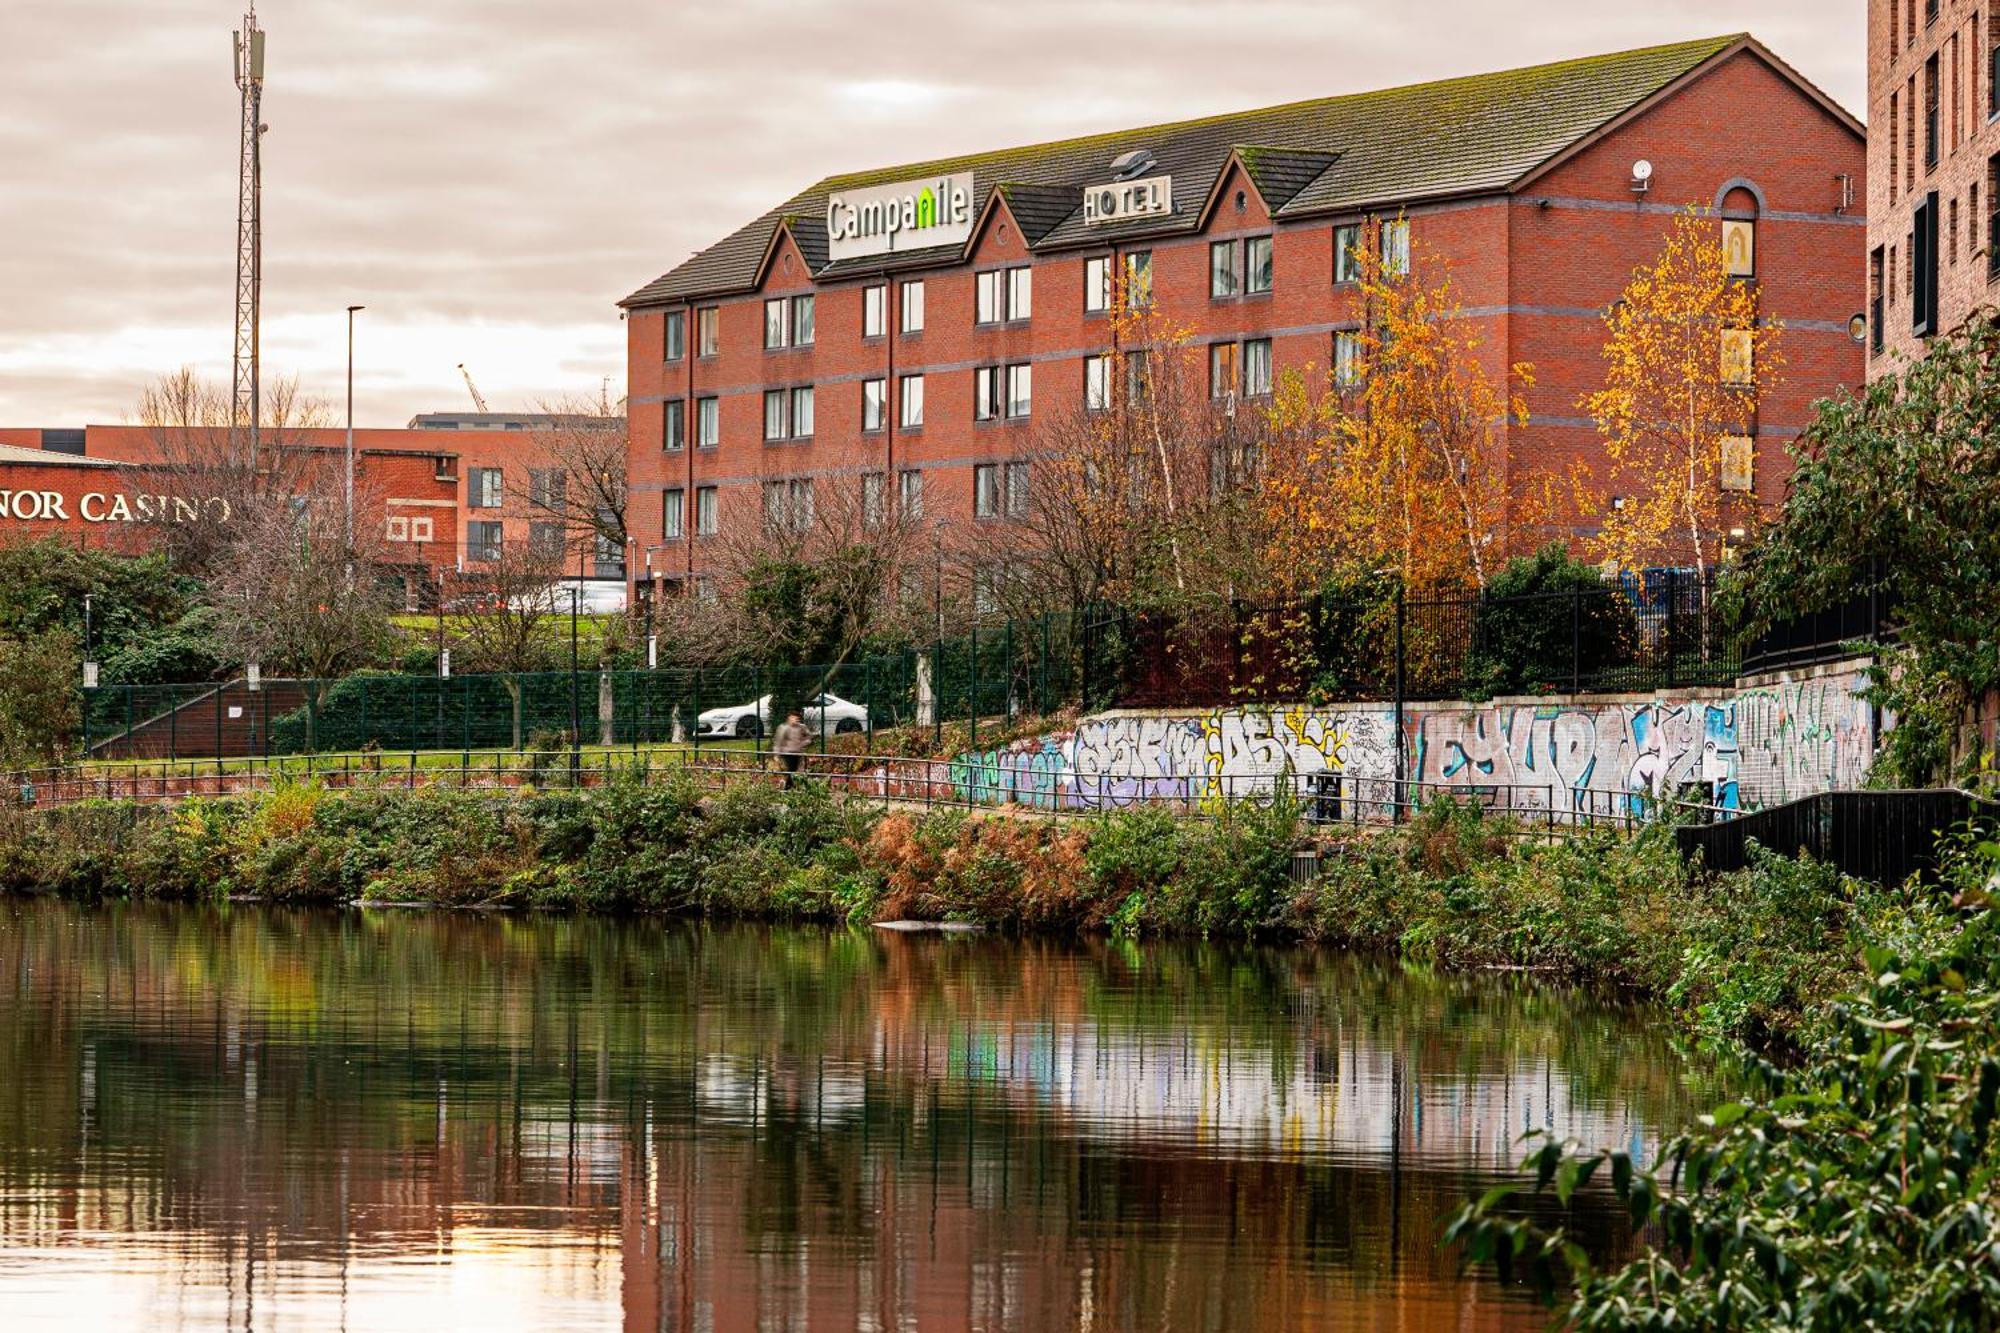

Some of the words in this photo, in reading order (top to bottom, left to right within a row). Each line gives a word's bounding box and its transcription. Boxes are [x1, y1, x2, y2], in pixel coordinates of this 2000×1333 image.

[828, 177, 968, 250] Campanile
[1084, 184, 1163, 218] HOTEL
[80, 493, 232, 523] CASINO
